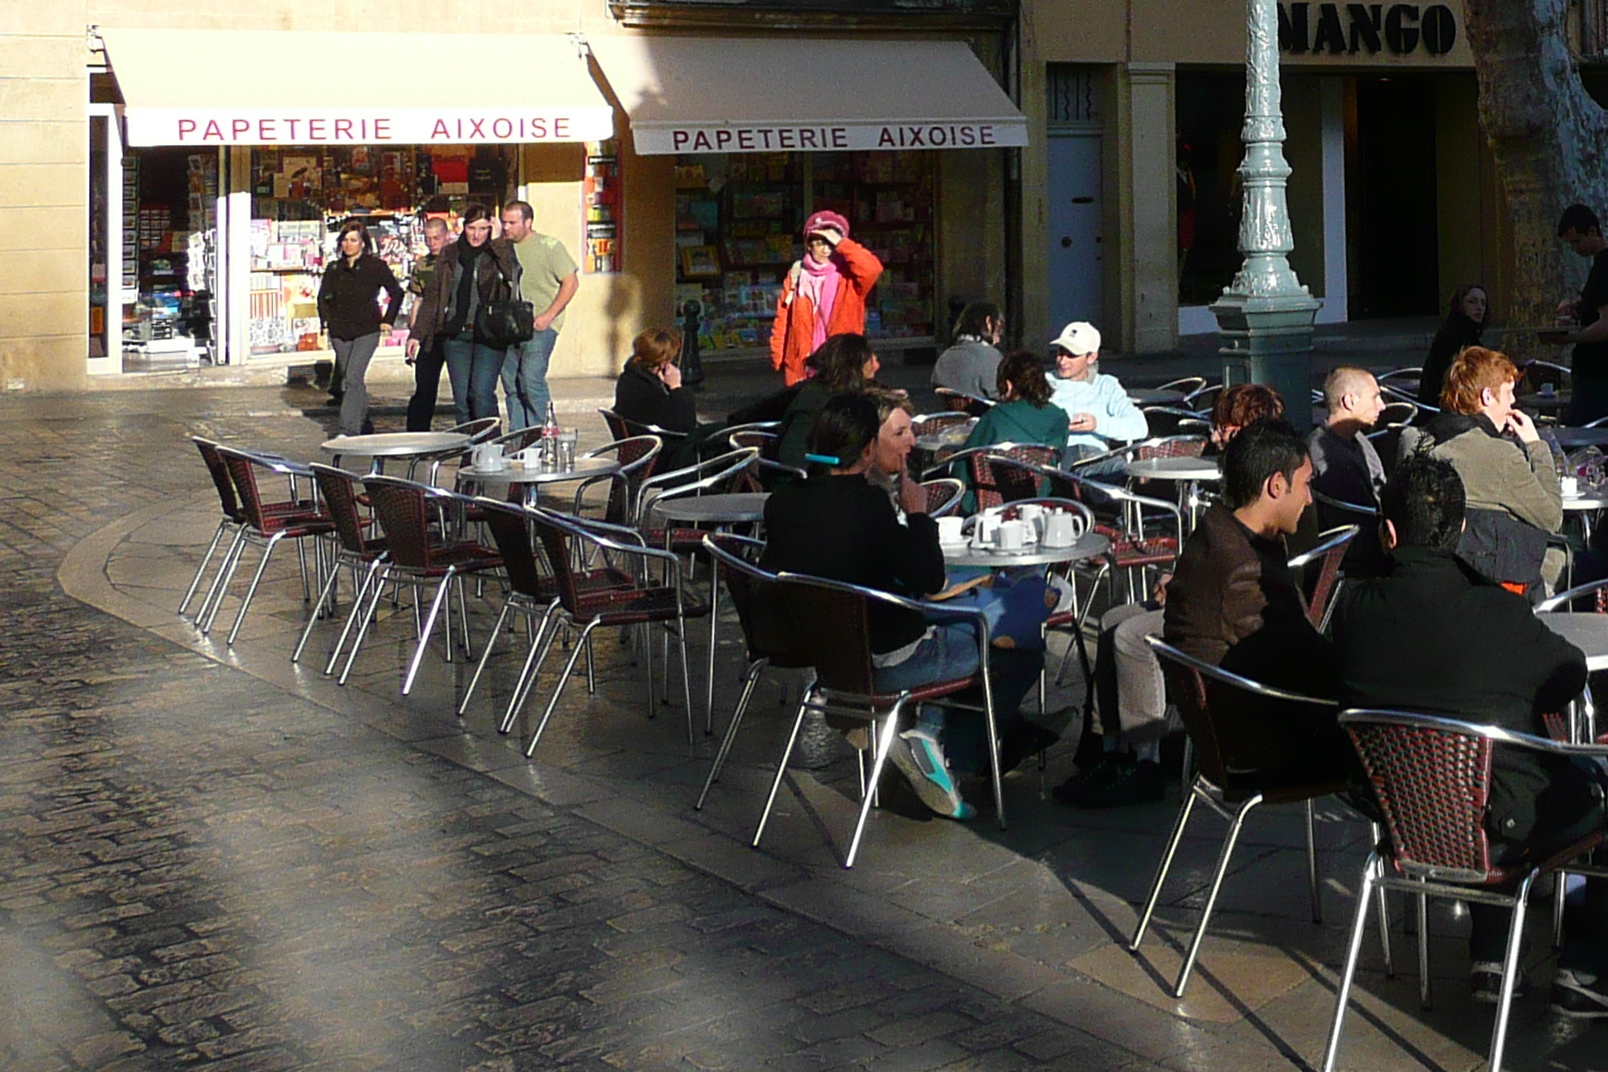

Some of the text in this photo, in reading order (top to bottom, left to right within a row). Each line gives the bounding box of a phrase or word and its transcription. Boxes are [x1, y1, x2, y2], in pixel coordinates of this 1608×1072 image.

[1277, 2, 1456, 55] MANGO
[177, 117, 571, 141] PAPETERIE AIXOISE
[672, 125, 996, 151] PAPETERIE AIXOISE
